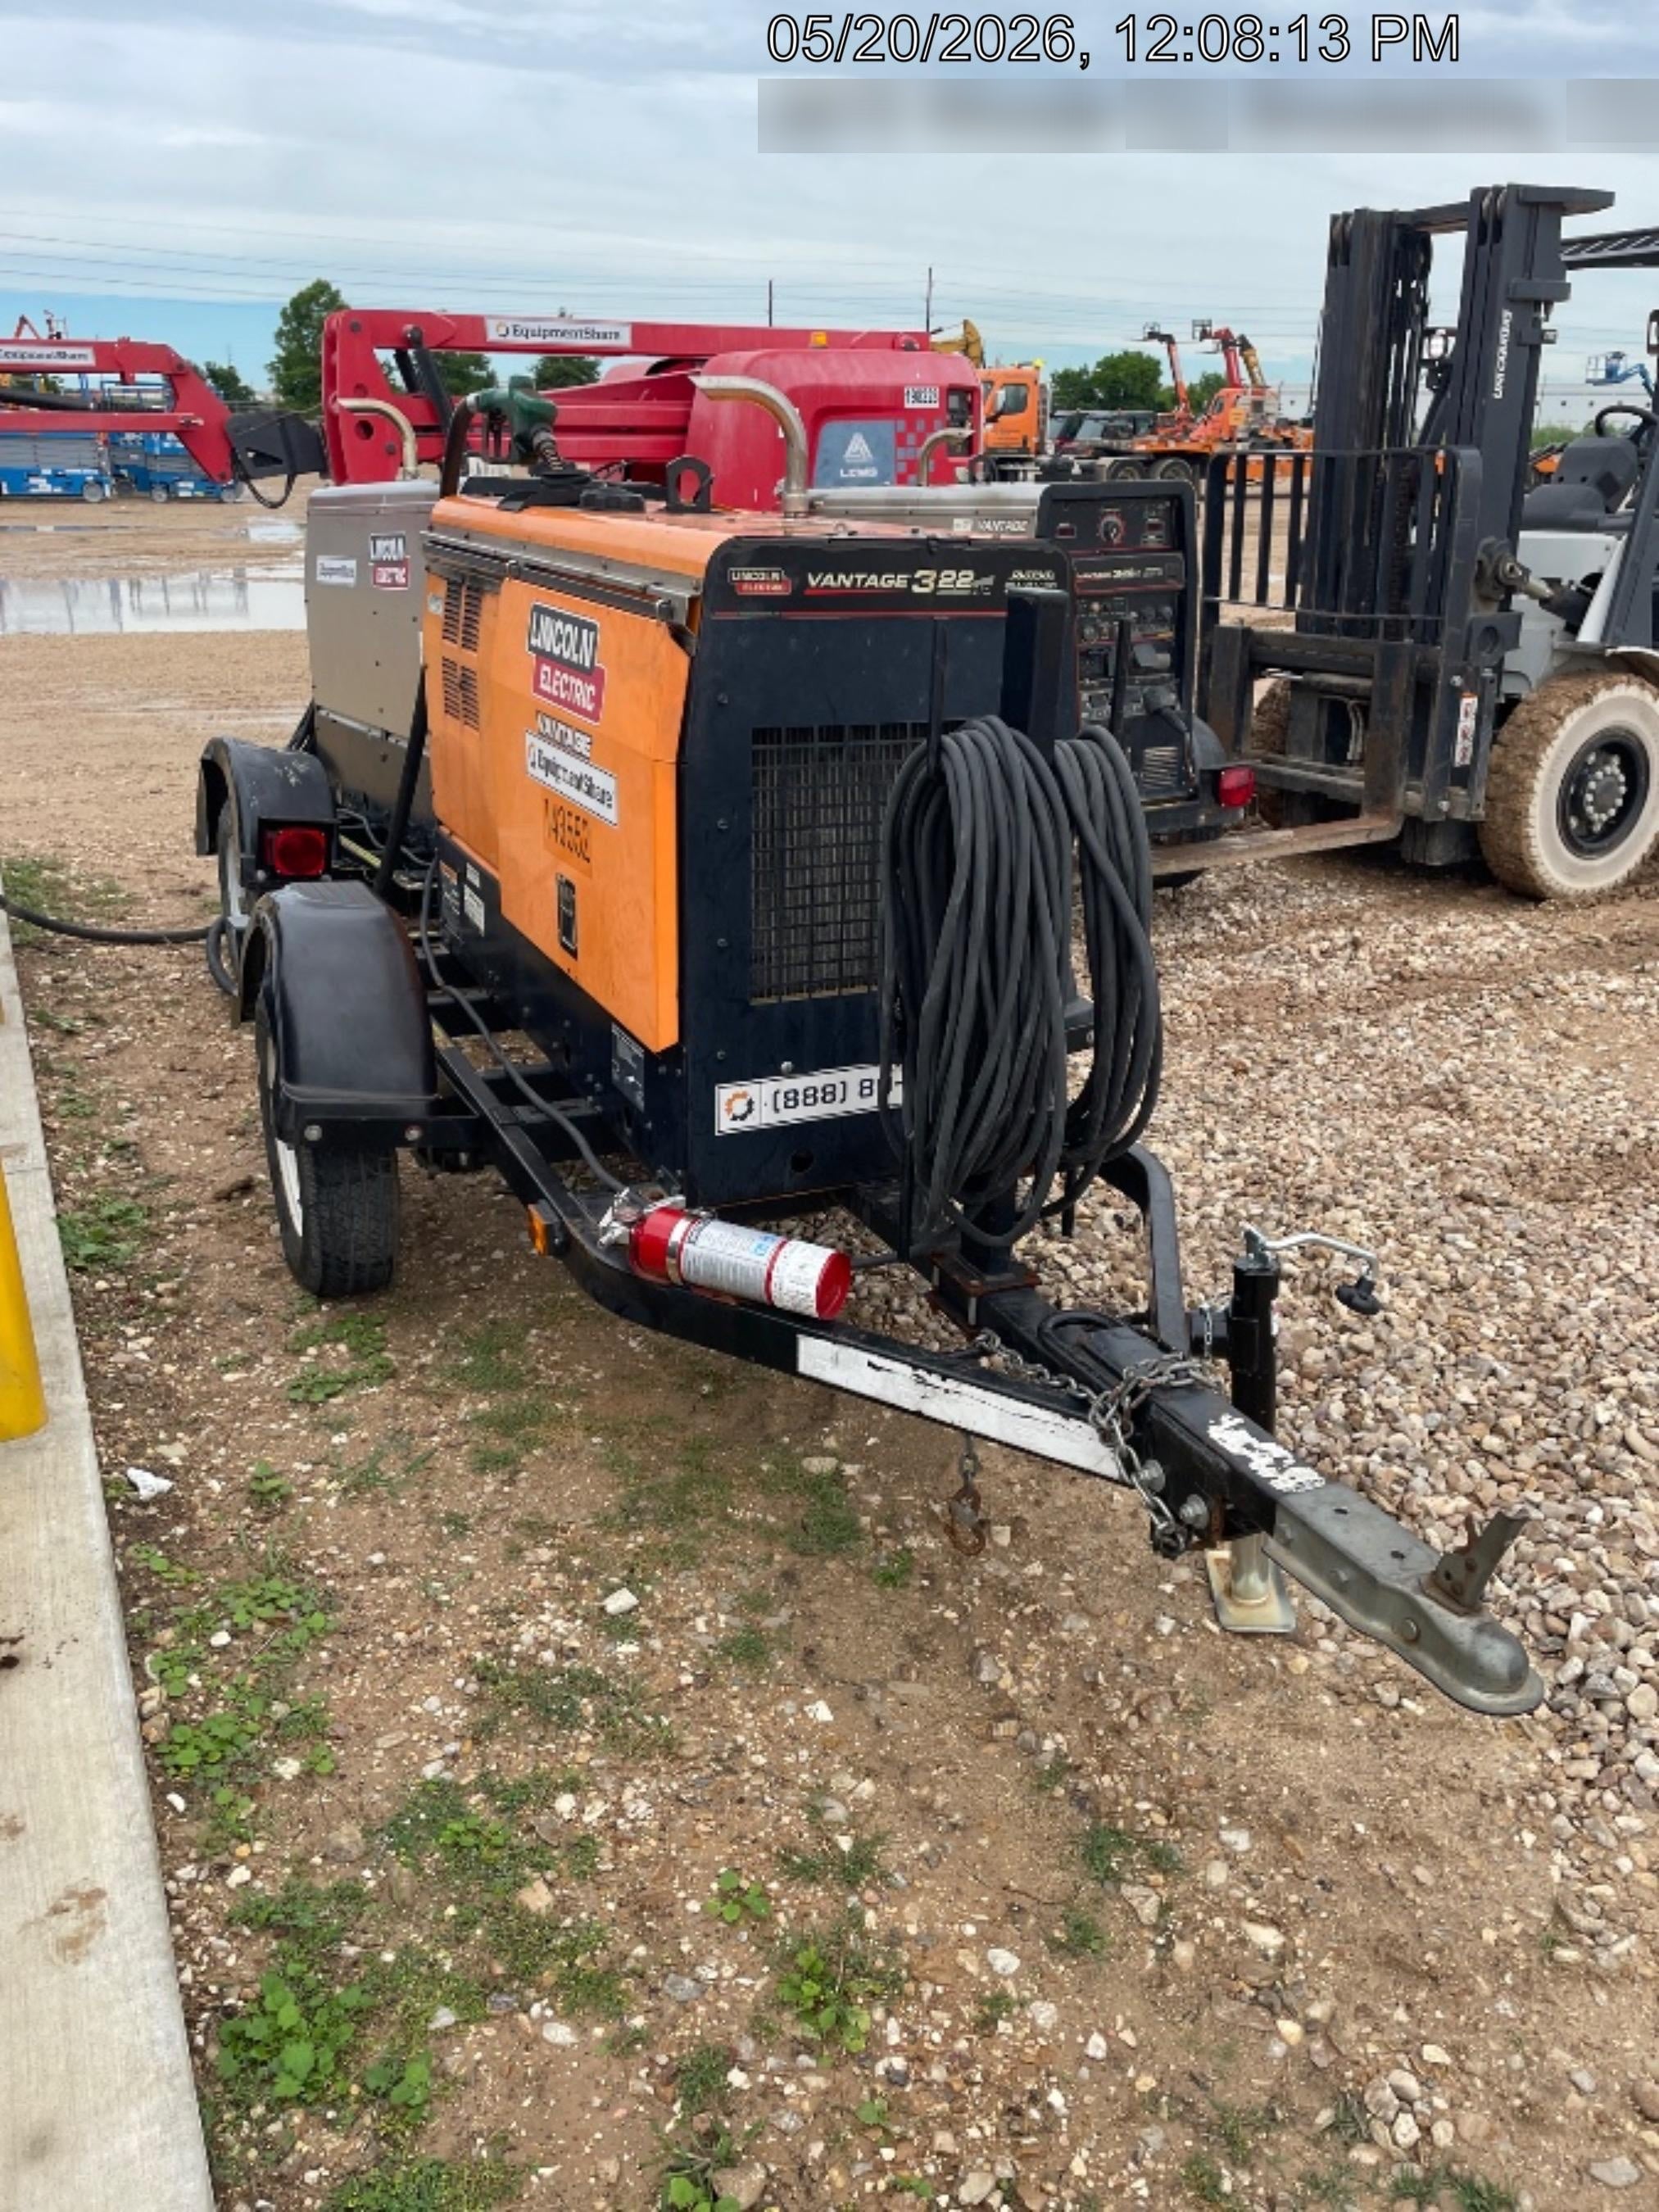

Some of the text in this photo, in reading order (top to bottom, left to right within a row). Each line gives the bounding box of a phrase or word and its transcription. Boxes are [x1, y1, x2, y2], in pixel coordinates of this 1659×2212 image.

[511, 324, 620, 340] EquipmentShare
[807, 573, 912, 588] VANTAGE
[910, 569, 975, 594] 322
[530, 610, 596, 669] LINCOLN
[539, 662, 596, 712] ELECTRIC
[773, 1081, 846, 1113] (888)
